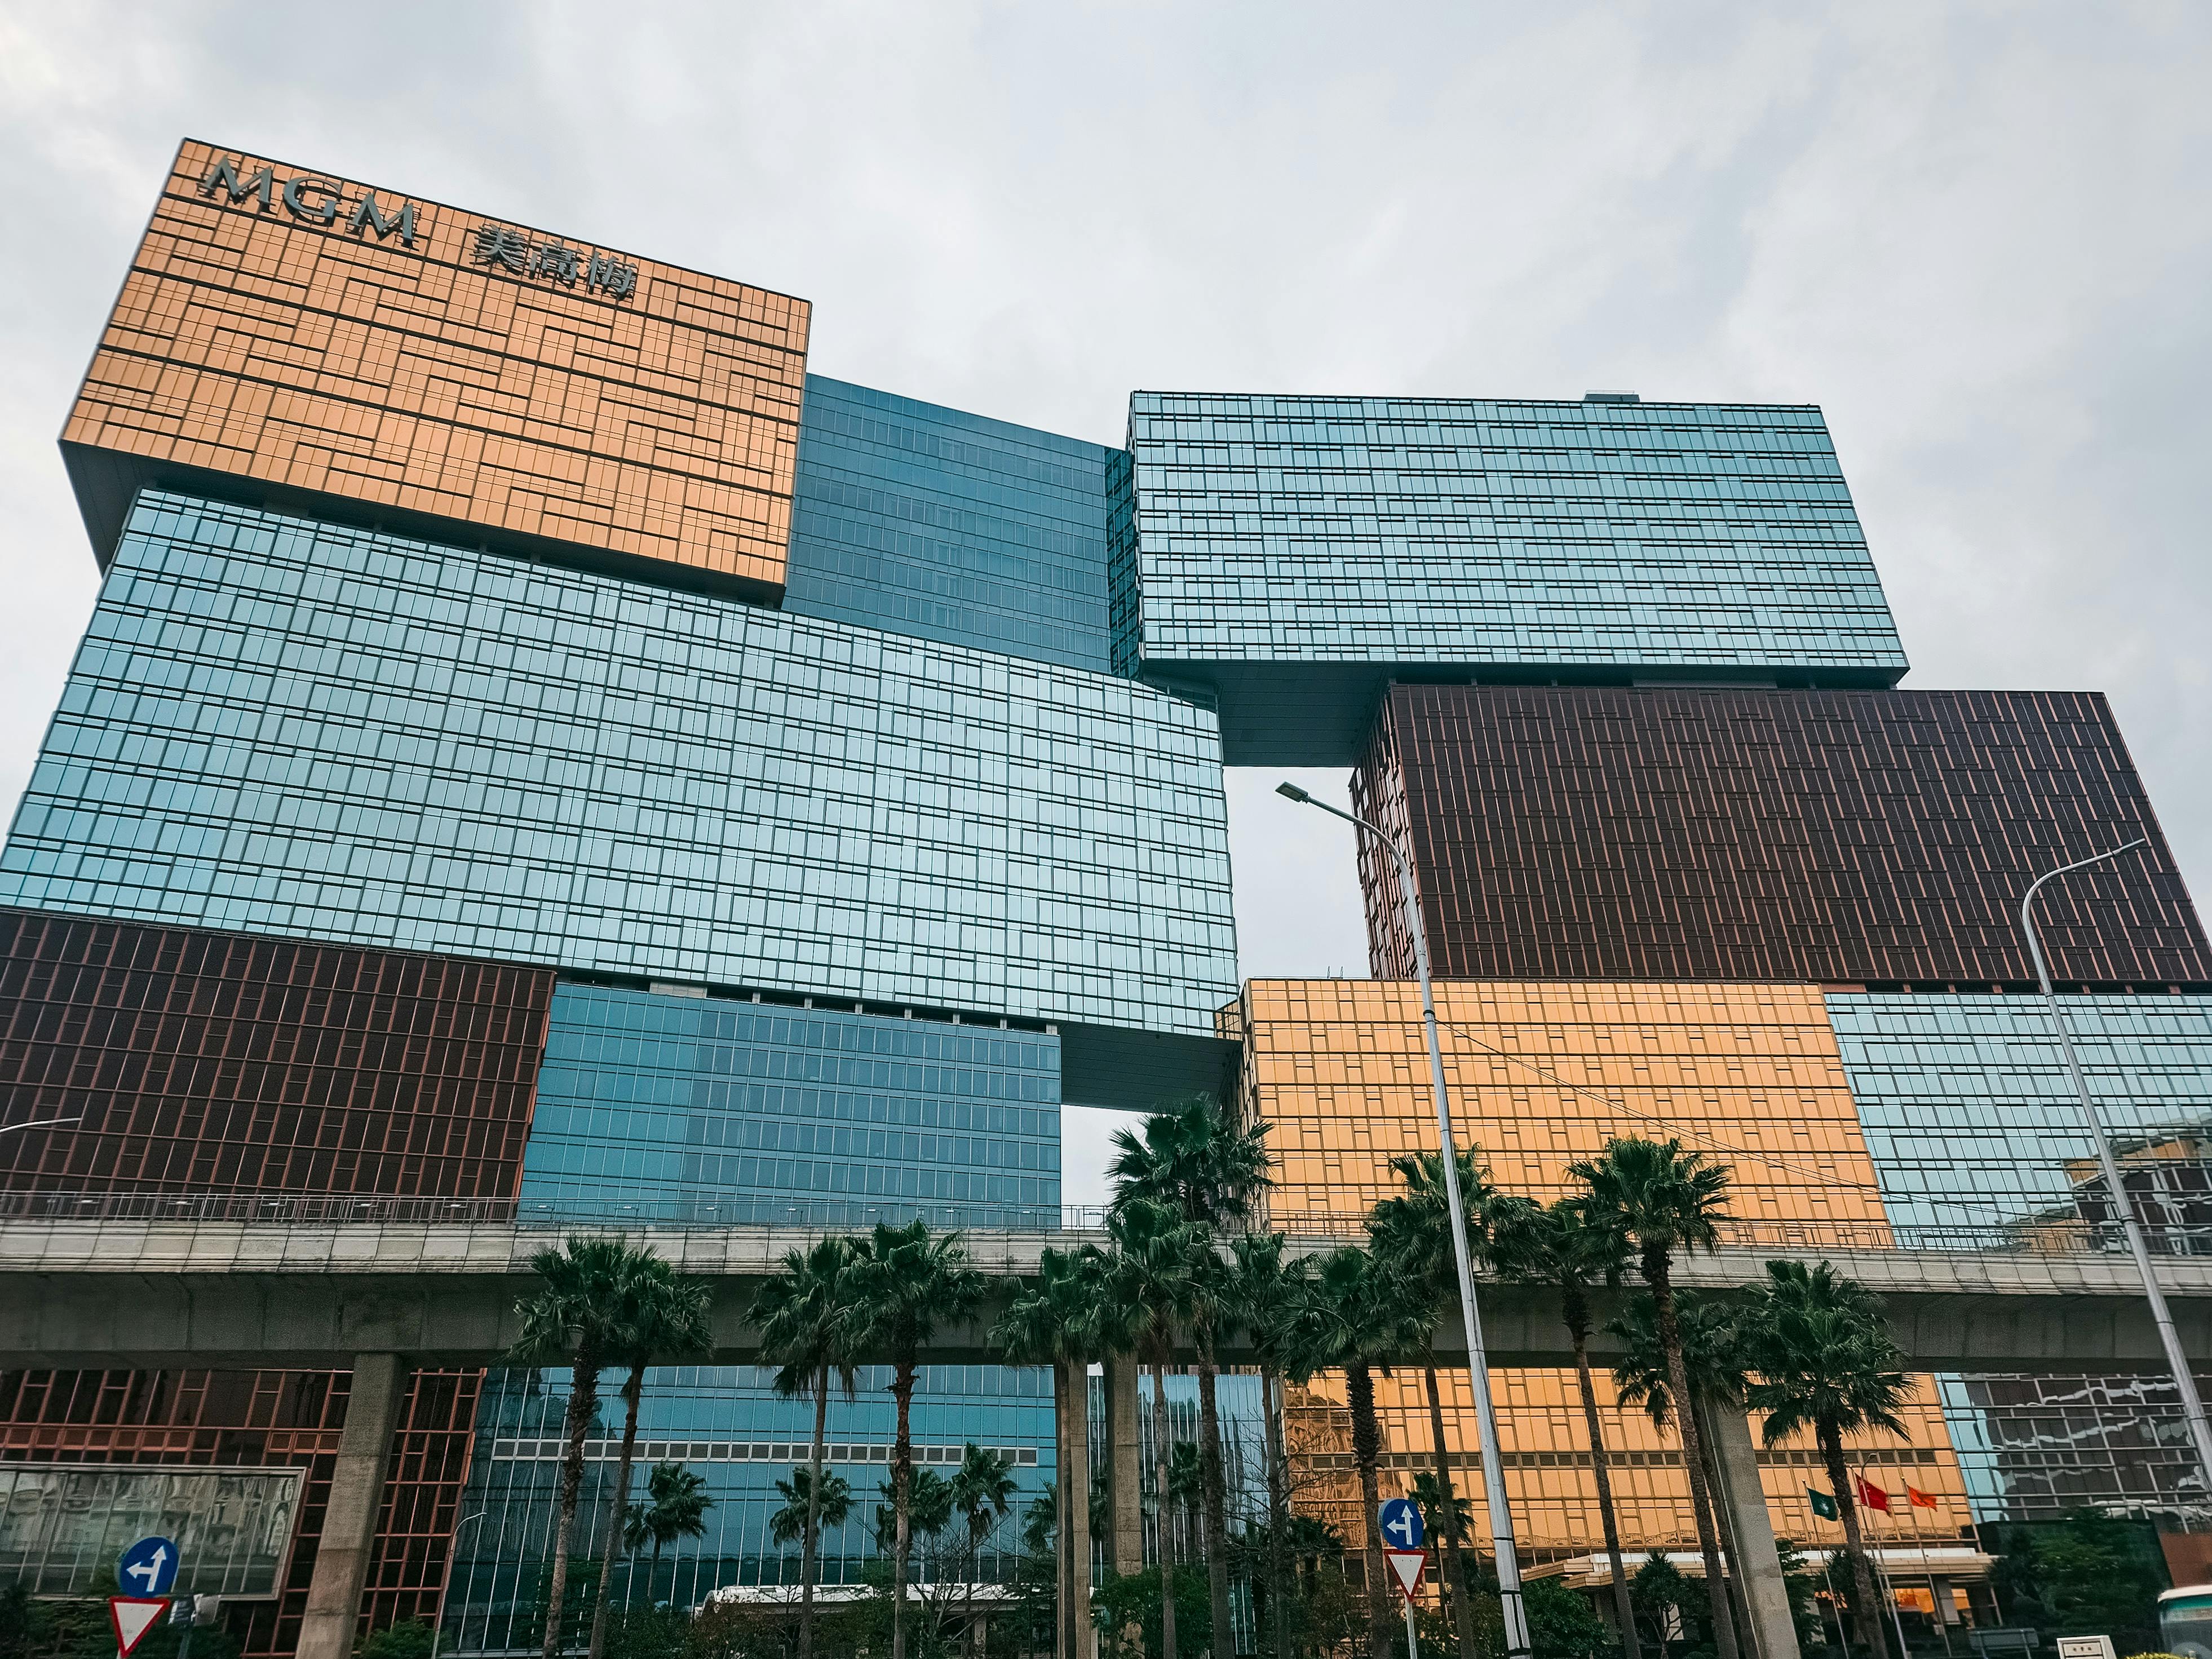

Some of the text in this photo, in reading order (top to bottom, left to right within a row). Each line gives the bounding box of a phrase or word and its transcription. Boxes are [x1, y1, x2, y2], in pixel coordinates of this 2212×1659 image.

[196, 154, 421, 250] MGM
[469, 223, 638, 300] 美高梅
